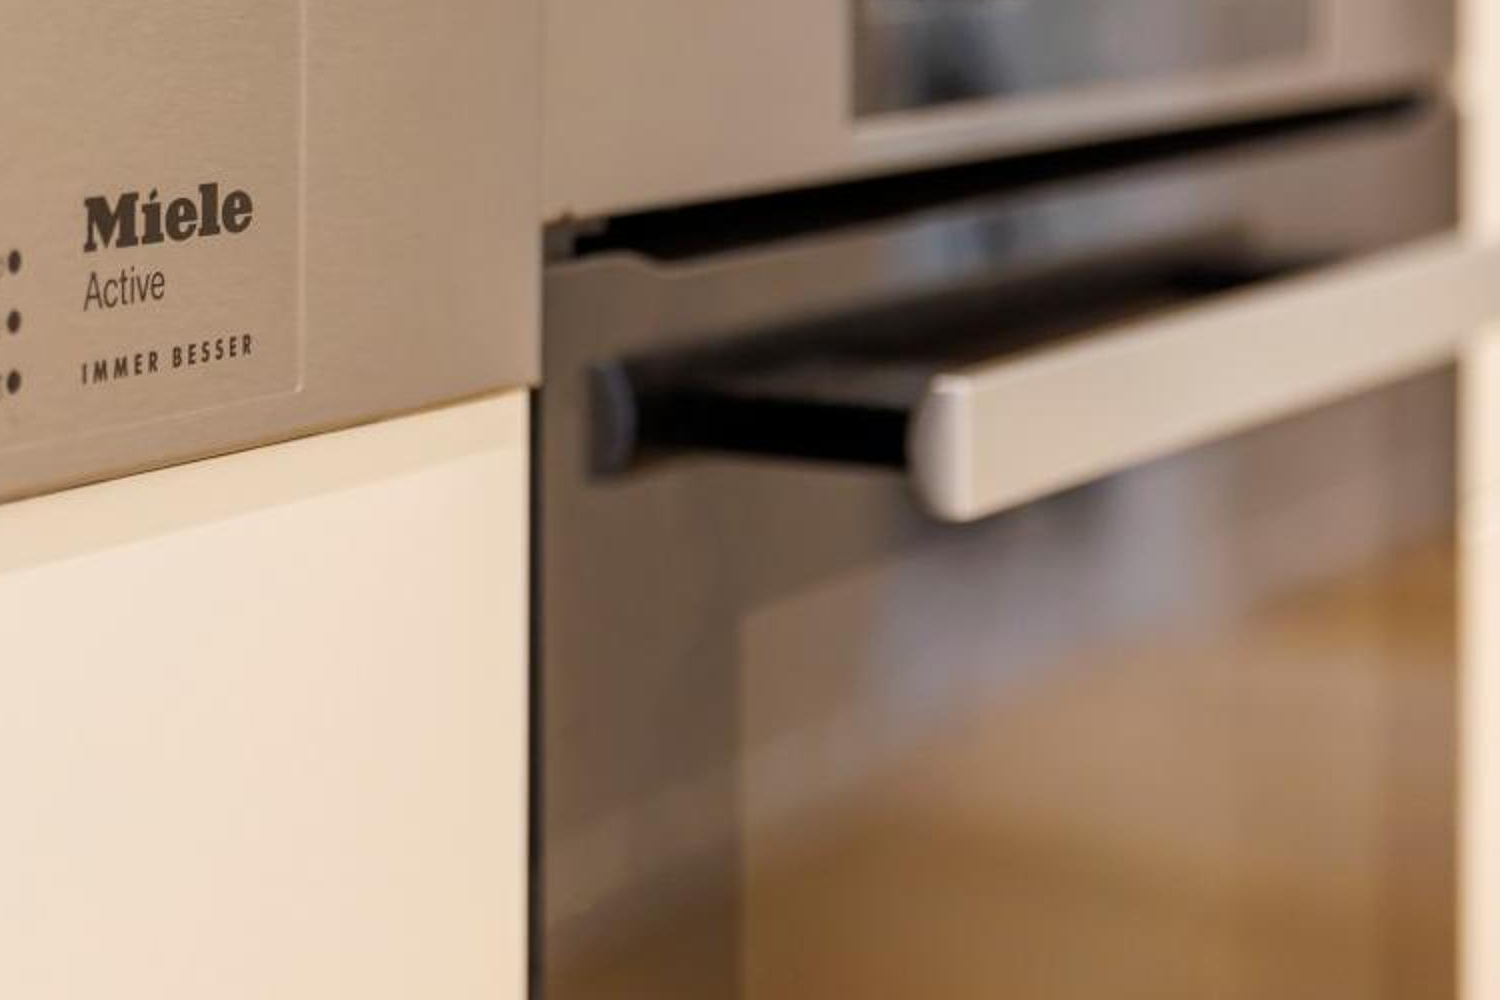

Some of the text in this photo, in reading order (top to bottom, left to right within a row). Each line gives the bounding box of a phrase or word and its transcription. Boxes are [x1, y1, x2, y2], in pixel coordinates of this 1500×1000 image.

[83, 182, 253, 253] Miele
[83, 266, 165, 312] Active
[82, 334, 253, 384] IMMER BESSER
